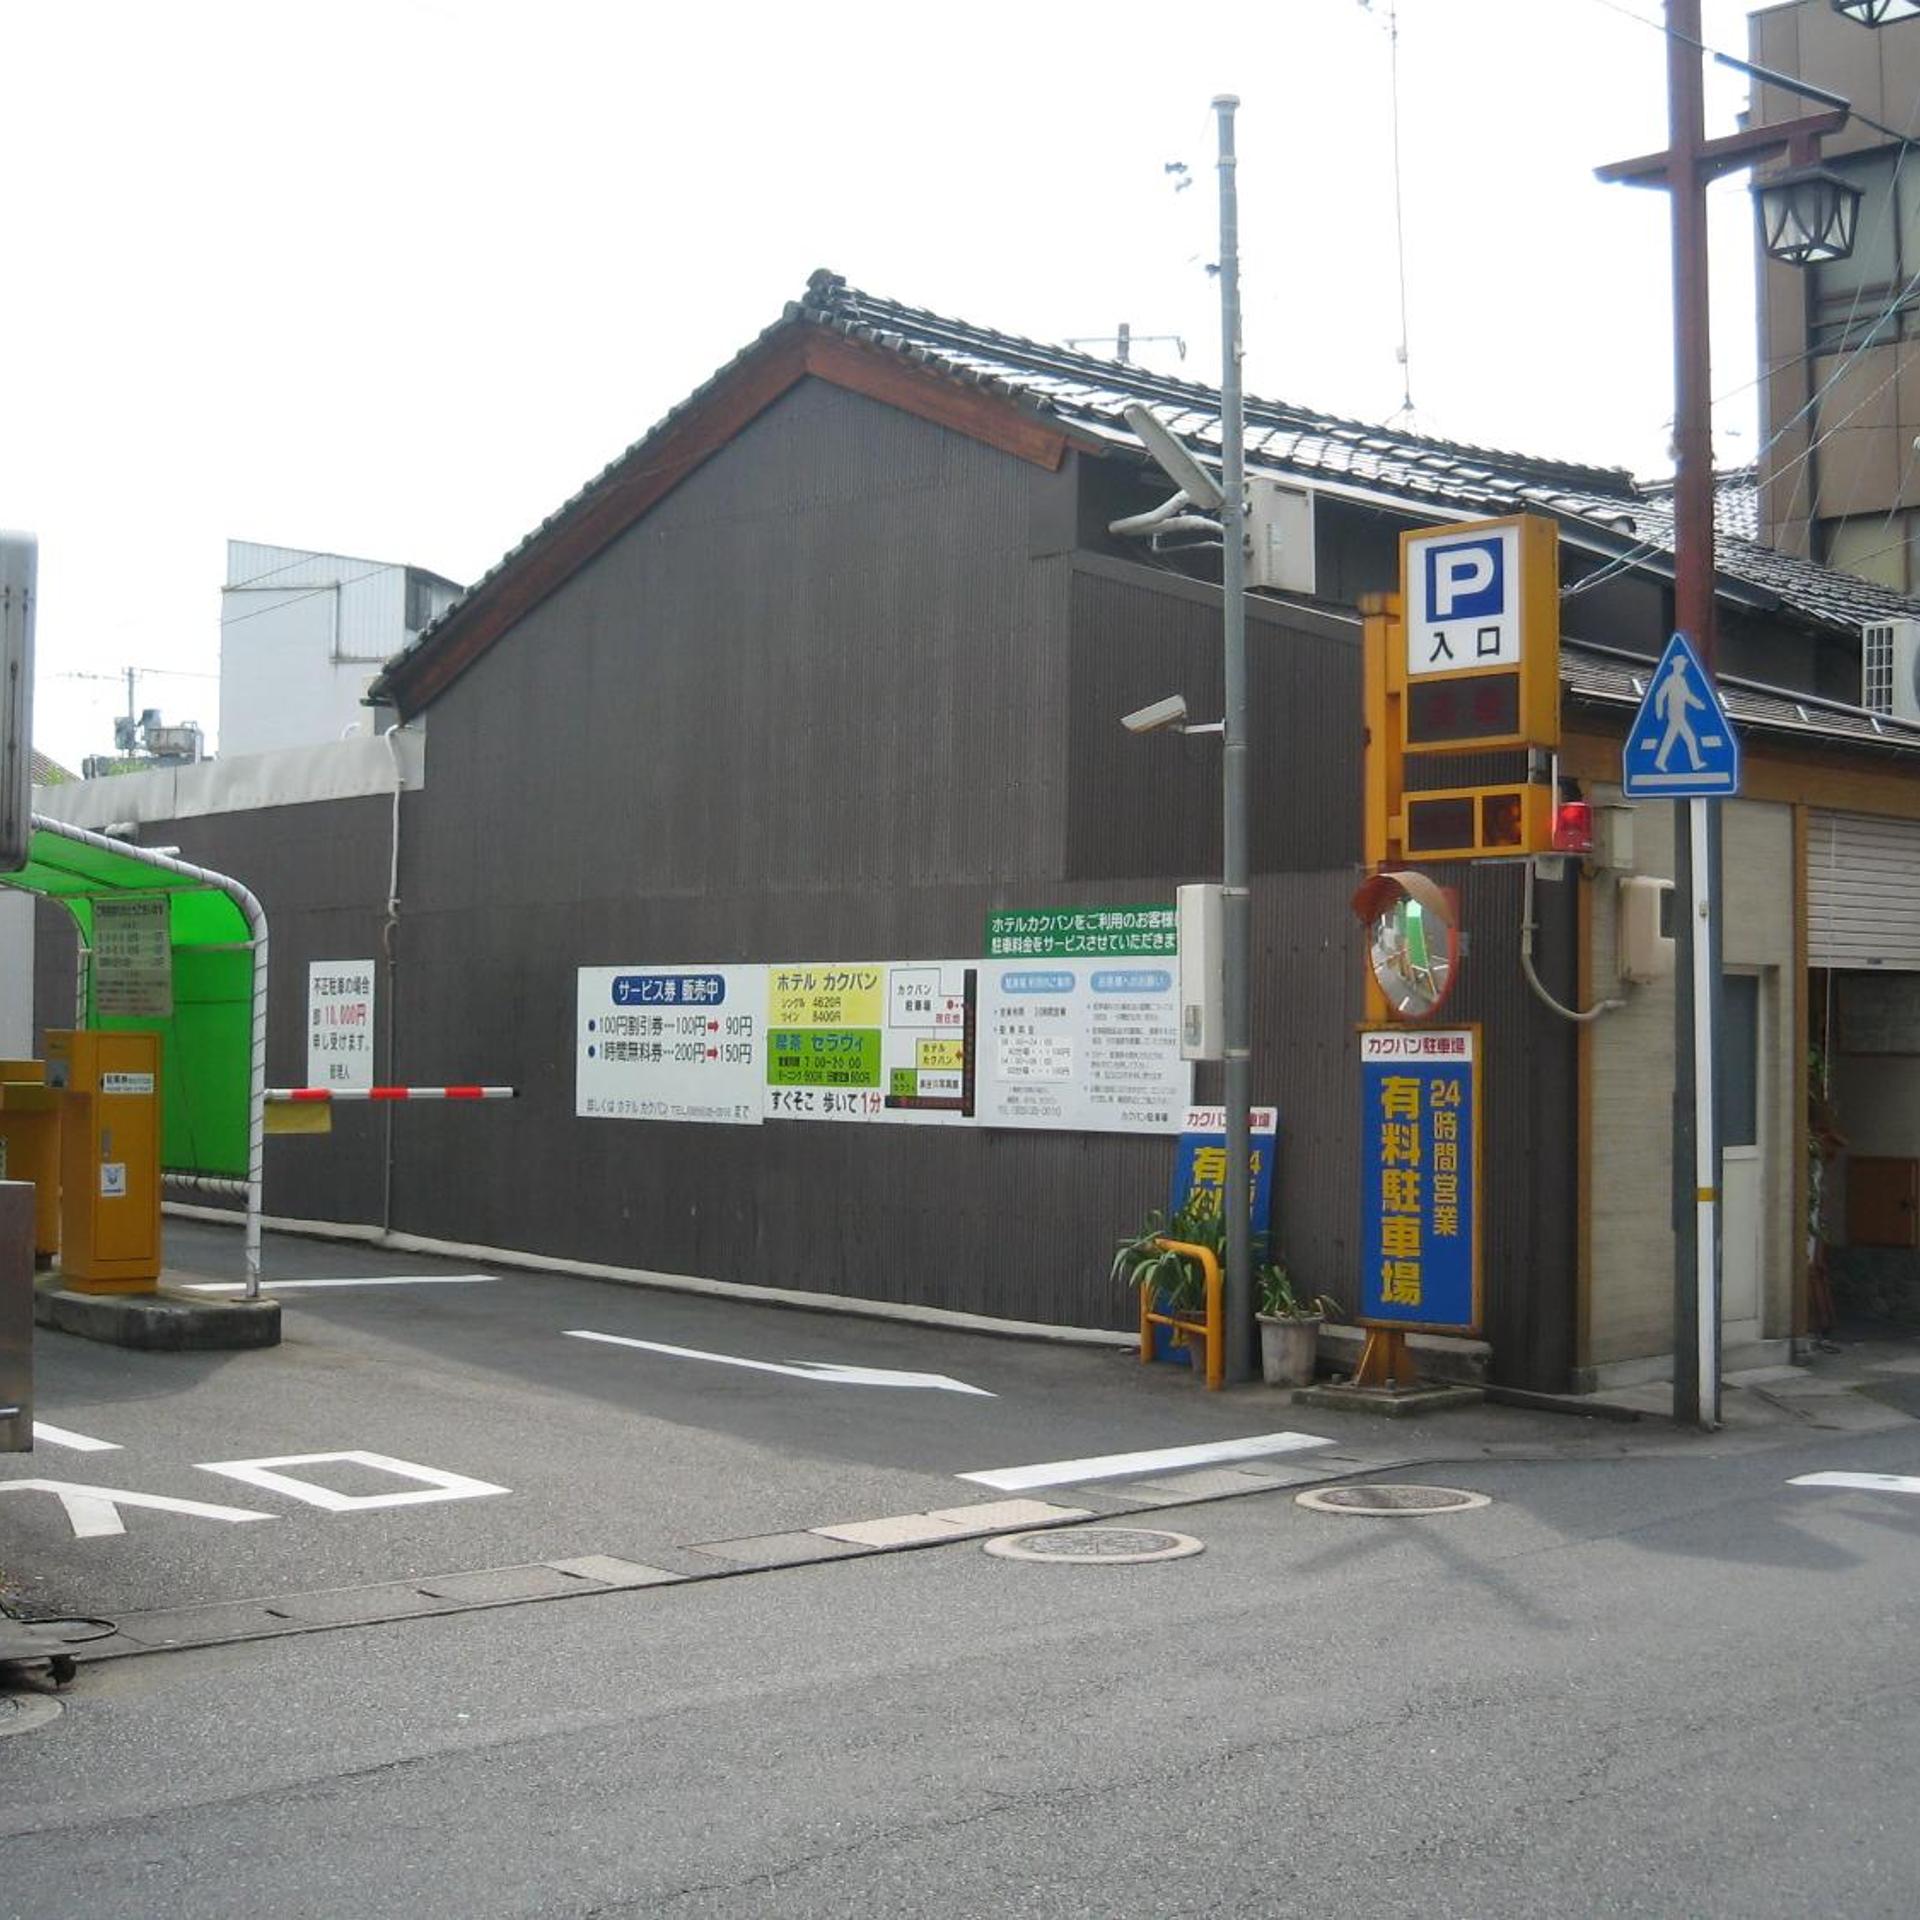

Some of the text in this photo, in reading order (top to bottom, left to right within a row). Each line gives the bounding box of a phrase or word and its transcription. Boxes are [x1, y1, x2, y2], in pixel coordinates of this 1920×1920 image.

[1436, 548, 1494, 615] P
[1430, 626, 1500, 662] 入口
[1368, 1036, 1466, 1055] カクバン駐車場
[771, 1092, 814, 1111] すぐそこ
[1430, 1079, 1461, 1236] 24時間営業
[1380, 1076, 1423, 1306] 有料駐車場
